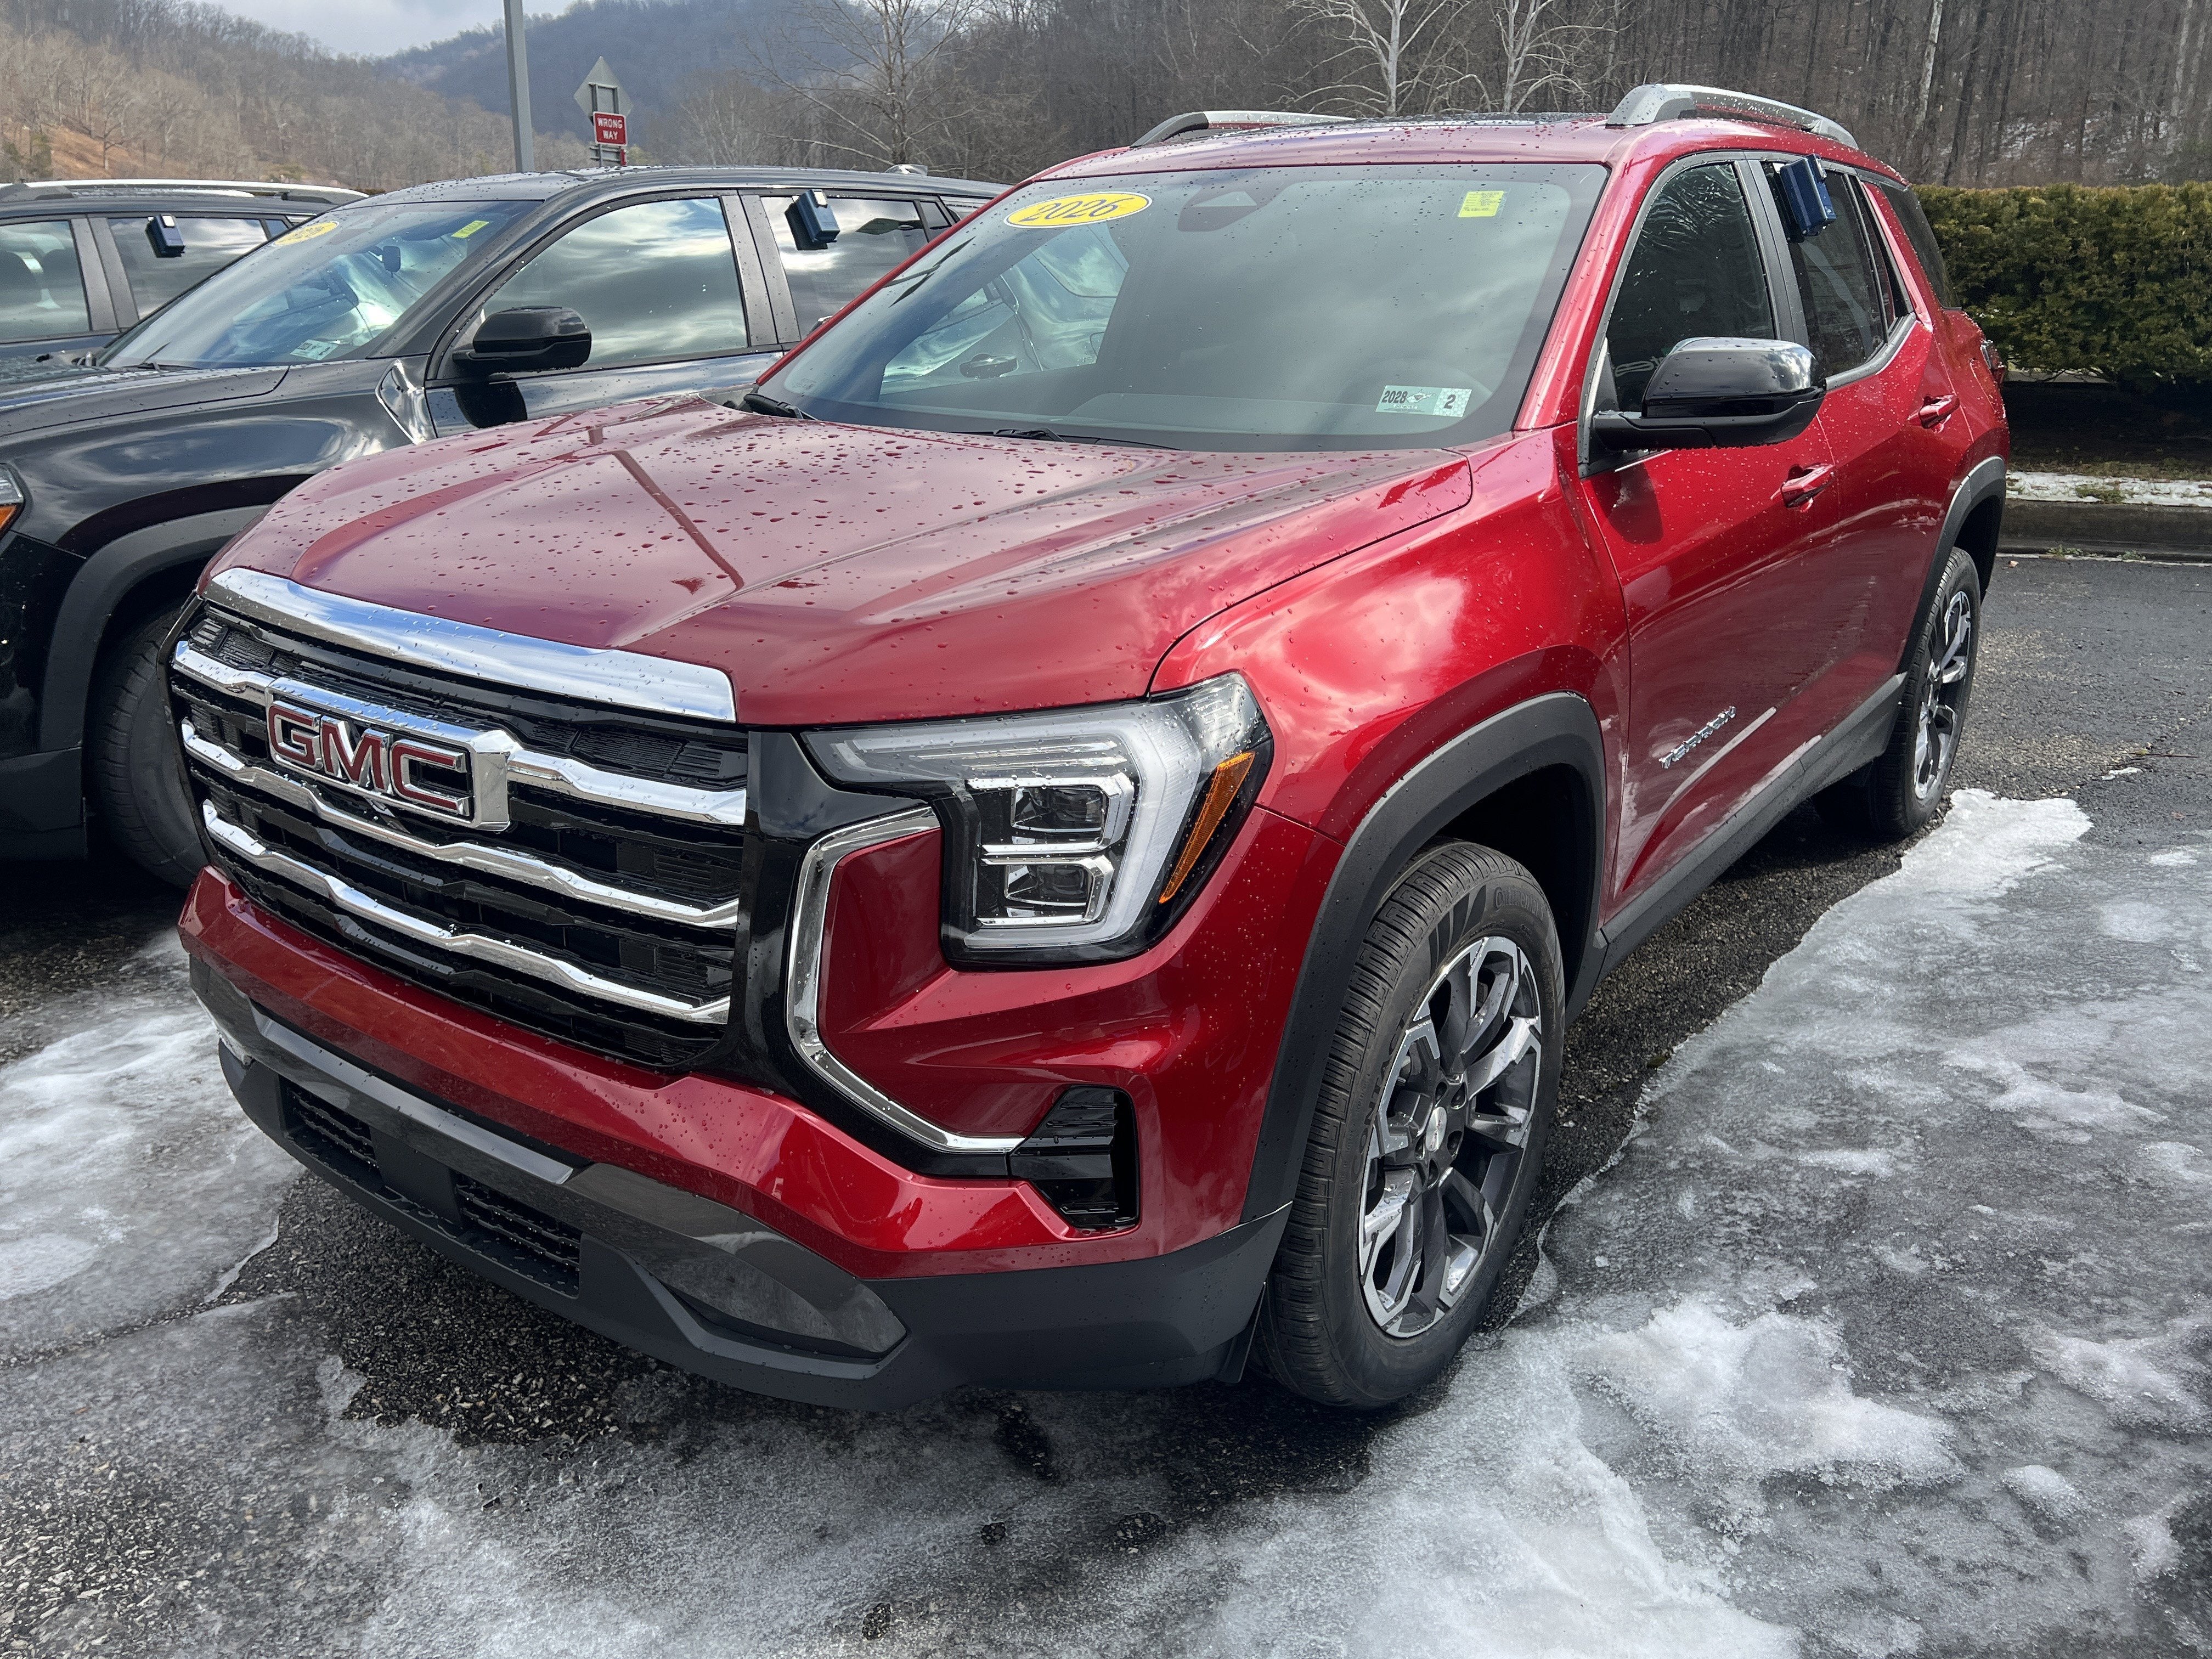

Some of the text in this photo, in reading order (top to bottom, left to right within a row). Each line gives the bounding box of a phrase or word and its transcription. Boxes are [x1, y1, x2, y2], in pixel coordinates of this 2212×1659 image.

[597, 117, 623, 129] WRONG
[602, 130, 618, 140] WAY
[1018, 197, 1135, 222] 2026
[1381, 390, 1456, 409] 2028 2
[268, 699, 471, 816] GMC
